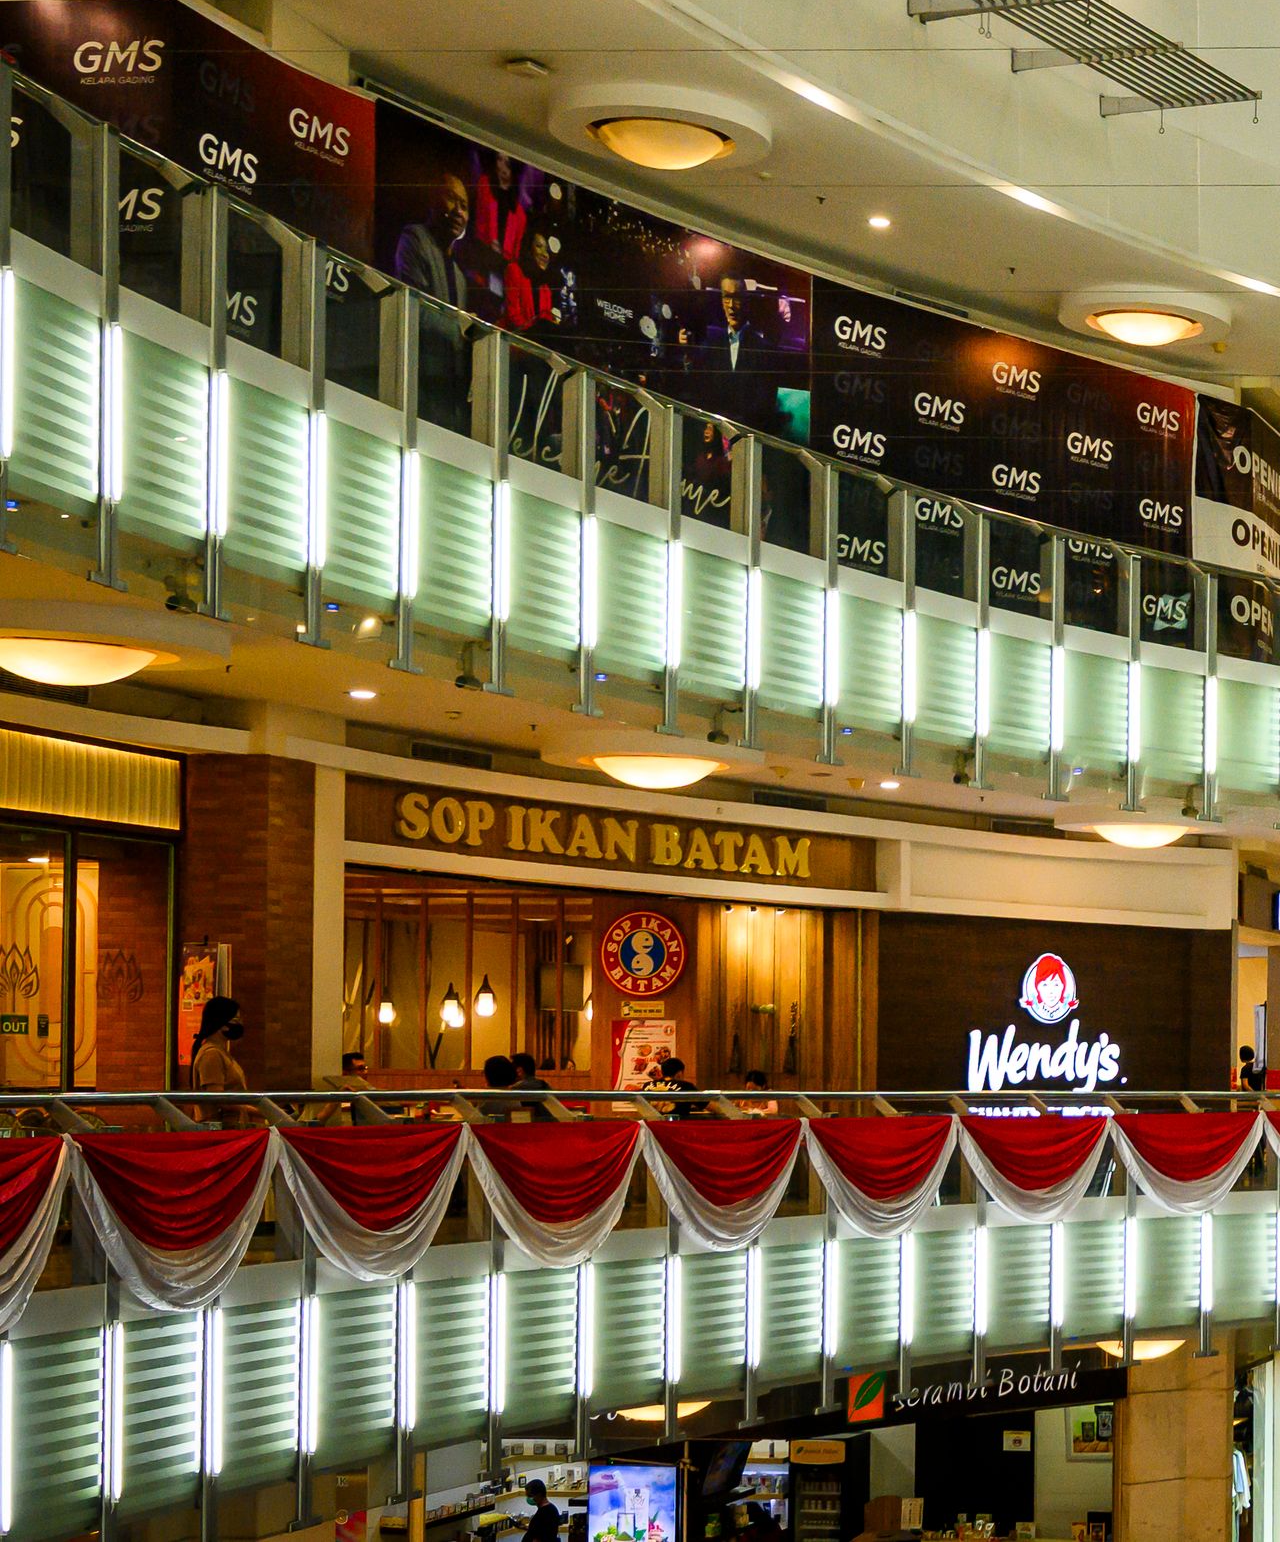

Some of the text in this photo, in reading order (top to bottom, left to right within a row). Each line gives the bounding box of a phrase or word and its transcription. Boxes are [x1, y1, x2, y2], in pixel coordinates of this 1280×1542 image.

[73, 40, 165, 73] GMS
[80, 76, 155, 85] KELAPA GADING
[289, 107, 351, 156] GMS
[199, 133, 259, 184] GMS
[119, 188, 164, 220] MS
[225, 292, 258, 326] MS
[597, 298, 634, 319] WELCOME
[604, 310, 626, 324] HOME
[834, 315, 887, 350] GMS
[992, 362, 1042, 393] GMS
[914, 392, 966, 424] GMS
[1136, 402, 1181, 432] GMS
[832, 424, 887, 457] GMS
[1066, 432, 1114, 462] GMS
[992, 464, 1042, 494] GMS
[1139, 498, 1183, 526] GMS
[837, 533, 886, 565] GMS
[992, 566, 1041, 595] GMS
[1142, 594, 1187, 621] GMS
[400, 792, 812, 878] SOP IKAN BATAM
[606, 917, 680, 953] SOP IKAN
[610, 964, 676, 991] BATAM
[2, 1021, 27, 1033] OUT
